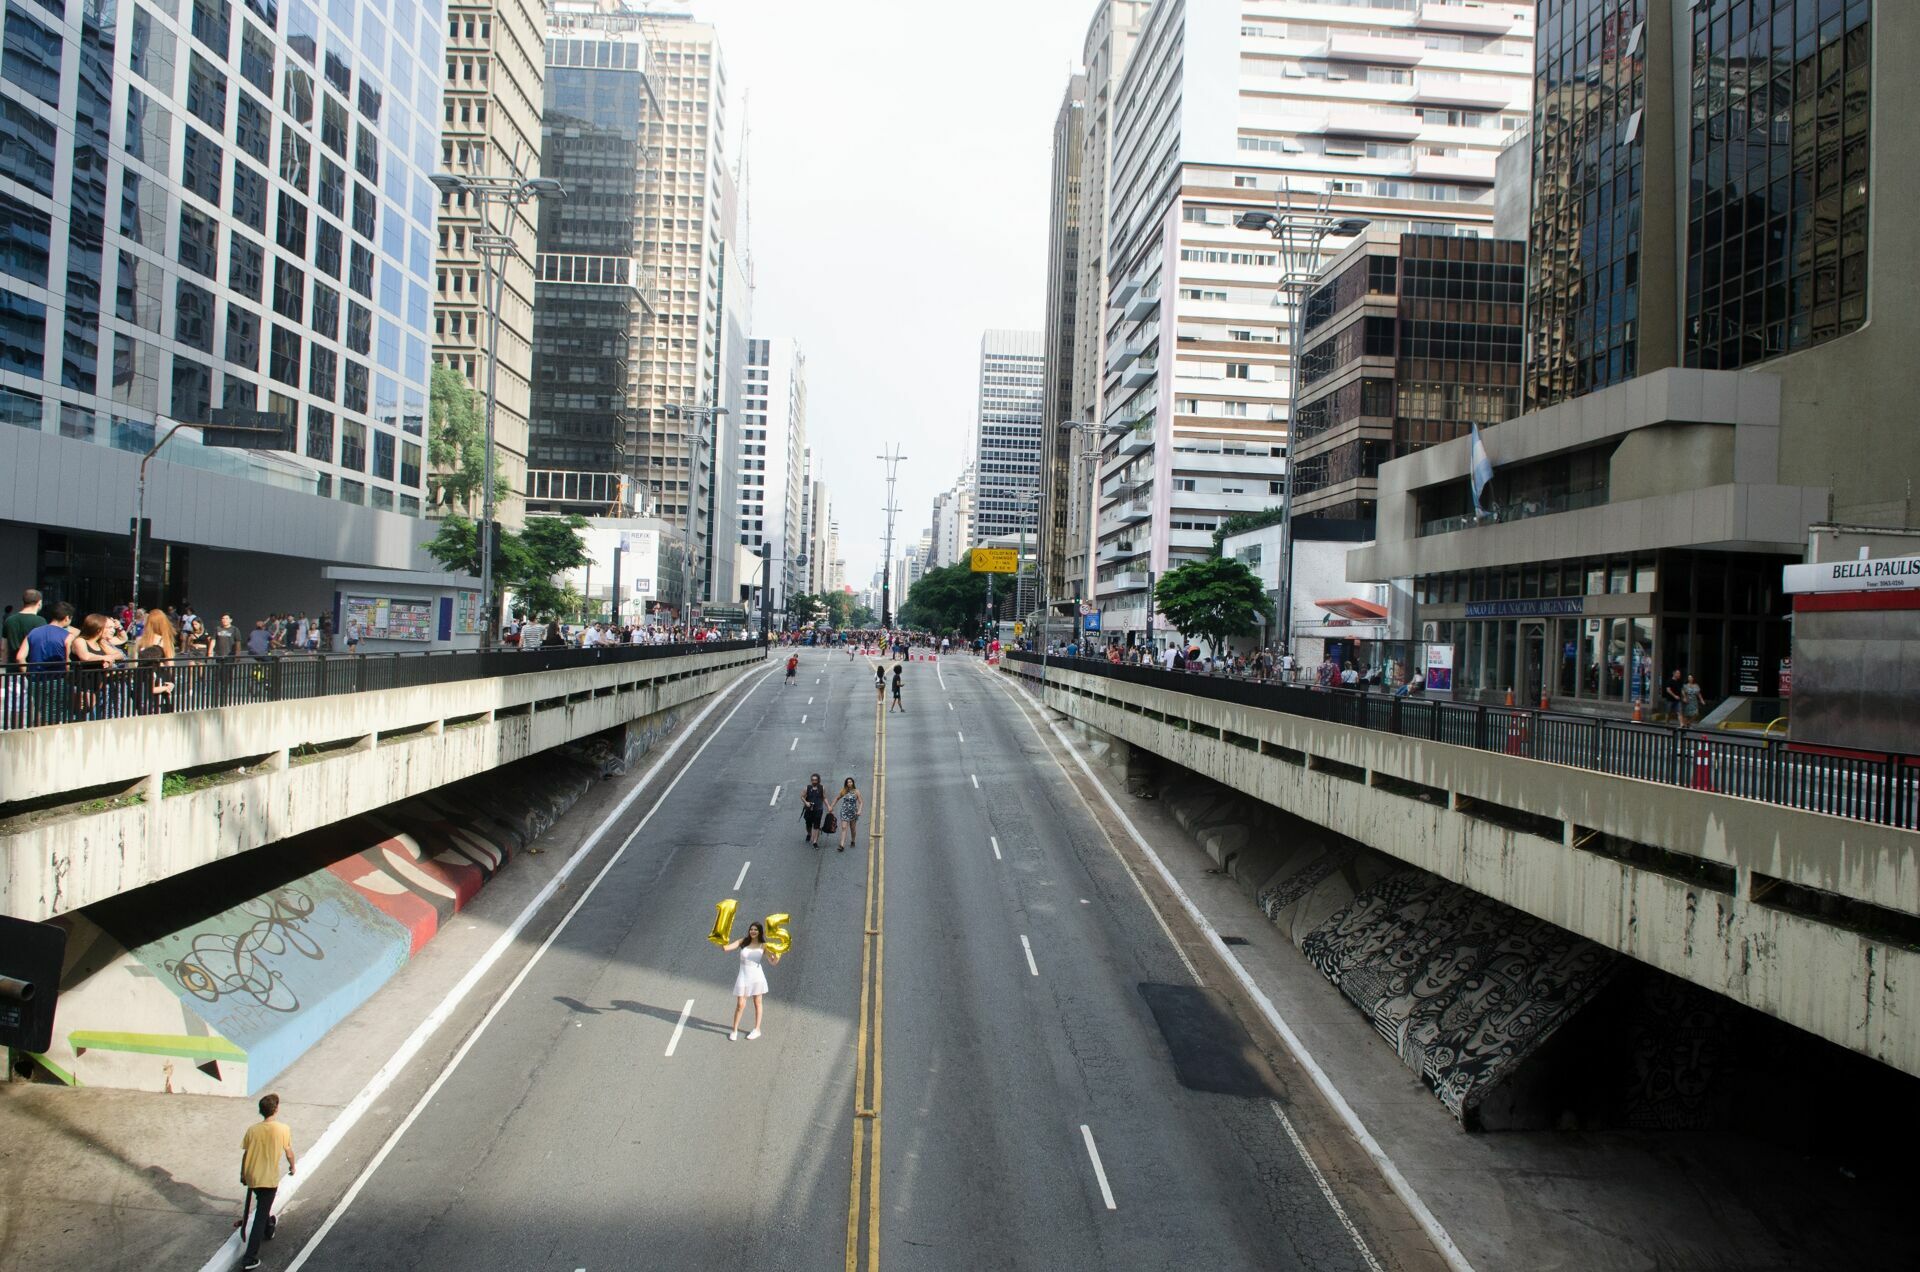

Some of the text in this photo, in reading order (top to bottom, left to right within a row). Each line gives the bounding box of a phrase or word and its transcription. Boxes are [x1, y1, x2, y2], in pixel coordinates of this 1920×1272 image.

[1832, 562, 1872, 579] BELLA
[1487, 603, 1497, 615] DE
[1498, 602, 1507, 614] LA
[1538, 599, 1583, 614] ARGENTINA
